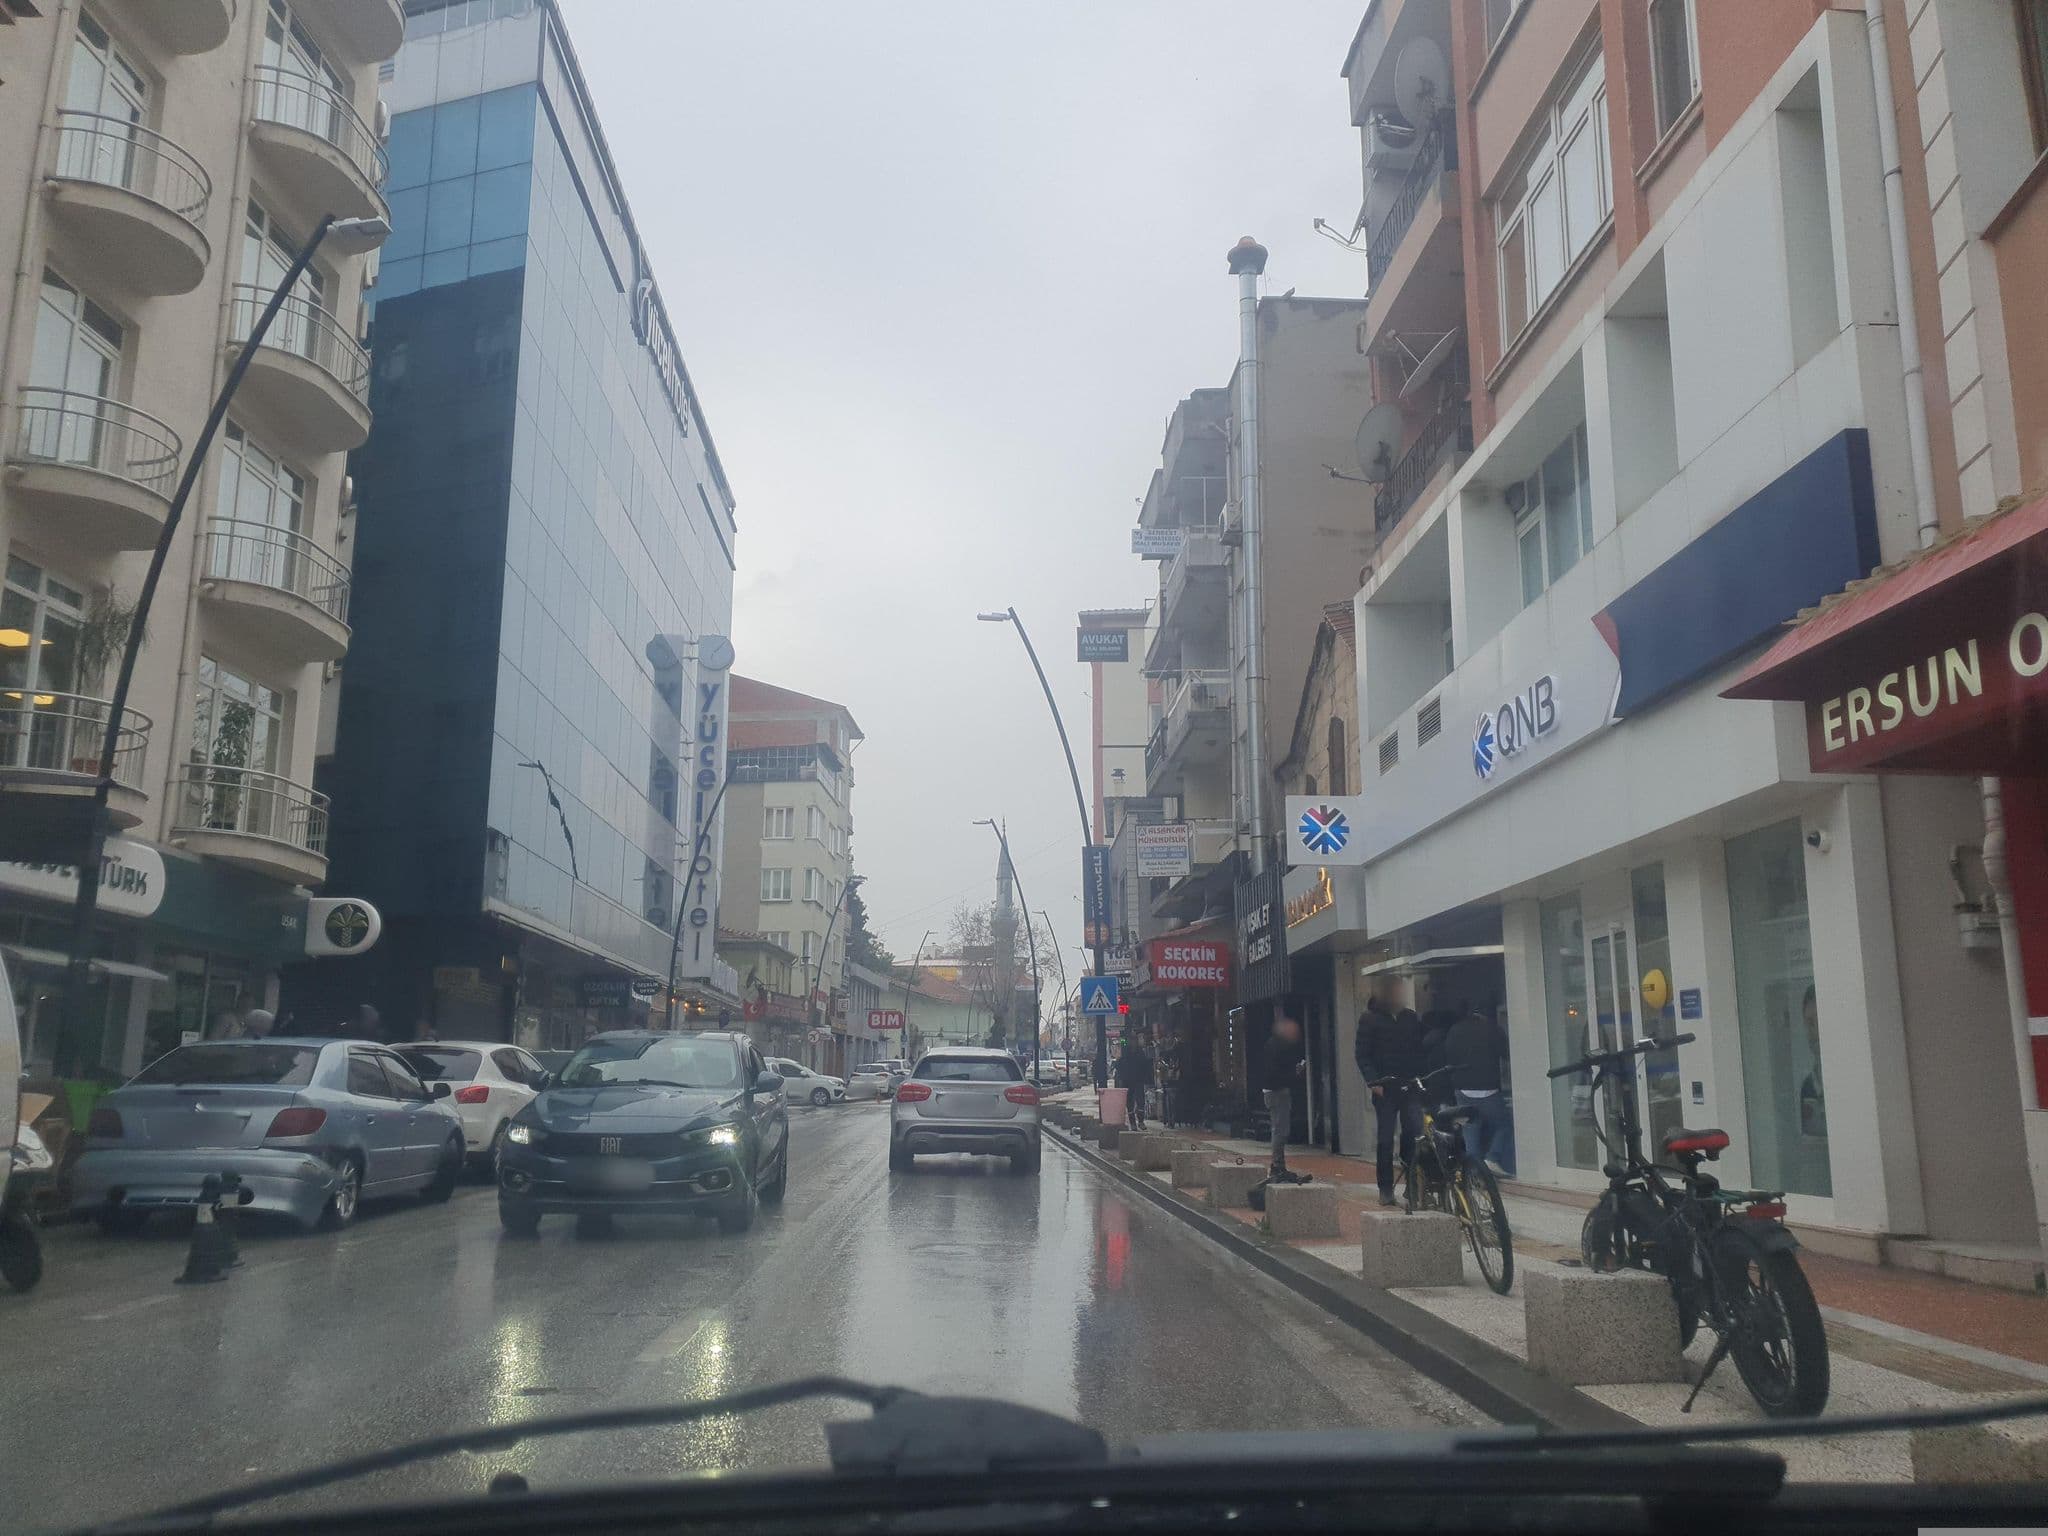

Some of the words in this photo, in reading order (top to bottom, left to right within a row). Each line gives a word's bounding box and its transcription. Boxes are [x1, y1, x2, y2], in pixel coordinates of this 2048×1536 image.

[1081, 634, 1125, 645] AVUKAT
[1822, 639, 1983, 752] ERSUN
[1496, 675, 1555, 757] QNB
[101, 855, 148, 896] TÜRK
[1164, 946, 1216, 962] SEÇKİN
[1157, 965, 1225, 982] KOKOREÇ
[871, 1012, 900, 1026] BİM
[600, 1136, 622, 1154] FIAT
